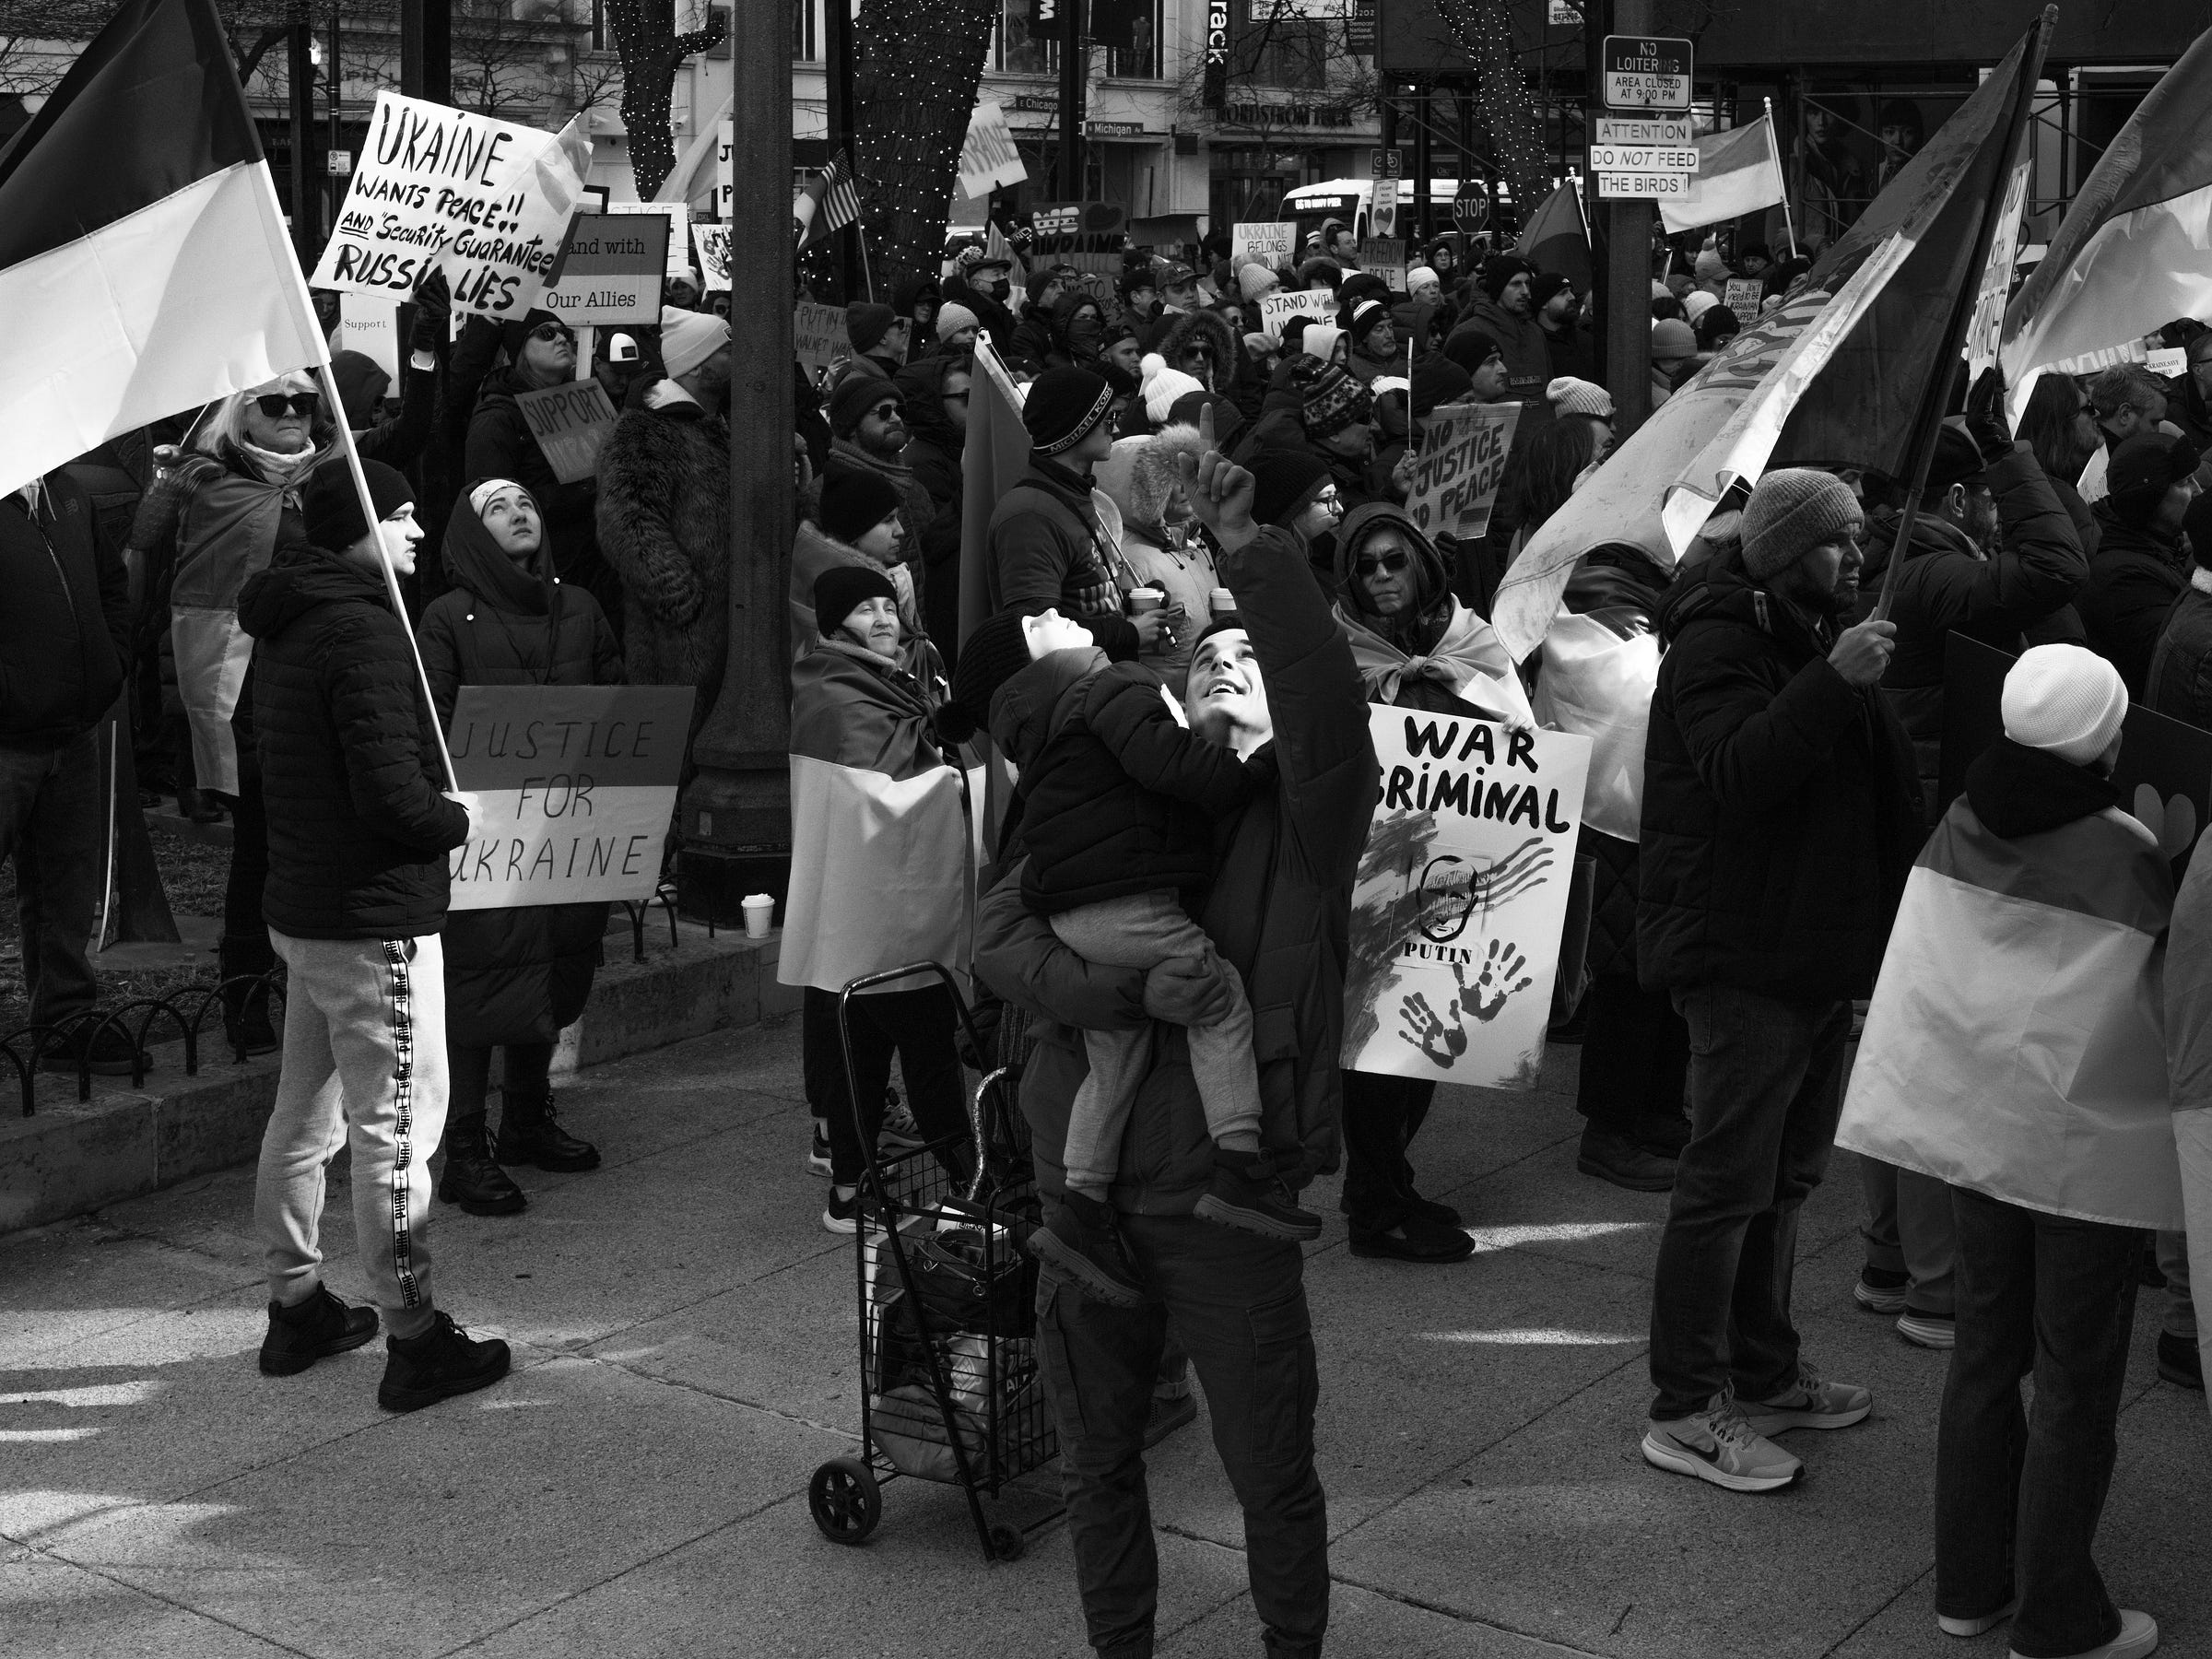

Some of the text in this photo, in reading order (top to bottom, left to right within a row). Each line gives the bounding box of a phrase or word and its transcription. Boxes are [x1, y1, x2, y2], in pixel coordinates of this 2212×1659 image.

[1207, 1, 1229, 65] rack
[1640, 42, 1657, 56] NO
[1617, 56, 1680, 73] LOITERING
[1615, 76, 1681, 88] AREA CLOSED
[1620, 88, 1676, 100] AT 9:00 PM
[1026, 98, 1059, 112] Chicago
[1094, 123, 1132, 136] Michigan
[1602, 124, 1687, 139] ATTENTION
[378, 103, 513, 186] UKAINE
[1593, 150, 1697, 167] DO NOT FEED
[356, 171, 430, 209] WANTS
[1600, 177, 1630, 192] THE
[1634, 178, 1678, 192] BIRDS
[1455, 198, 1487, 218] STOP
[341, 211, 373, 230] AND
[1032, 206, 1080, 236] WE
[1239, 224, 1288, 240] UKRAINE
[567, 238, 646, 255] and with
[1247, 240, 1288, 253] BELONGS
[1362, 241, 1404, 265] FREEDOM
[334, 243, 521, 311] RUSSI LIES
[547, 290, 637, 309] Our Allies
[1265, 294, 1308, 315] STAND
[345, 319, 387, 331] Support
[1050, 386, 1112, 452] MICHAEL KORS
[1426, 420, 1453, 457] NO
[1415, 423, 1505, 498] JUSTICE
[1441, 455, 1505, 522] PEACE
[451, 721, 653, 759] JUSTICE
[1404, 715, 1538, 773] WAR
[516, 773, 594, 819] FOR
[450, 836, 648, 882] UKRAINE
[1403, 942, 1472, 964] PUTIN
[394, 973, 407, 1004] PUMA
[396, 1021, 411, 1053] PUMA
[394, 1187, 406, 1219] PUMA
[395, 1230, 408, 1259] PUMA
[401, 1274, 418, 1307] PUMA
